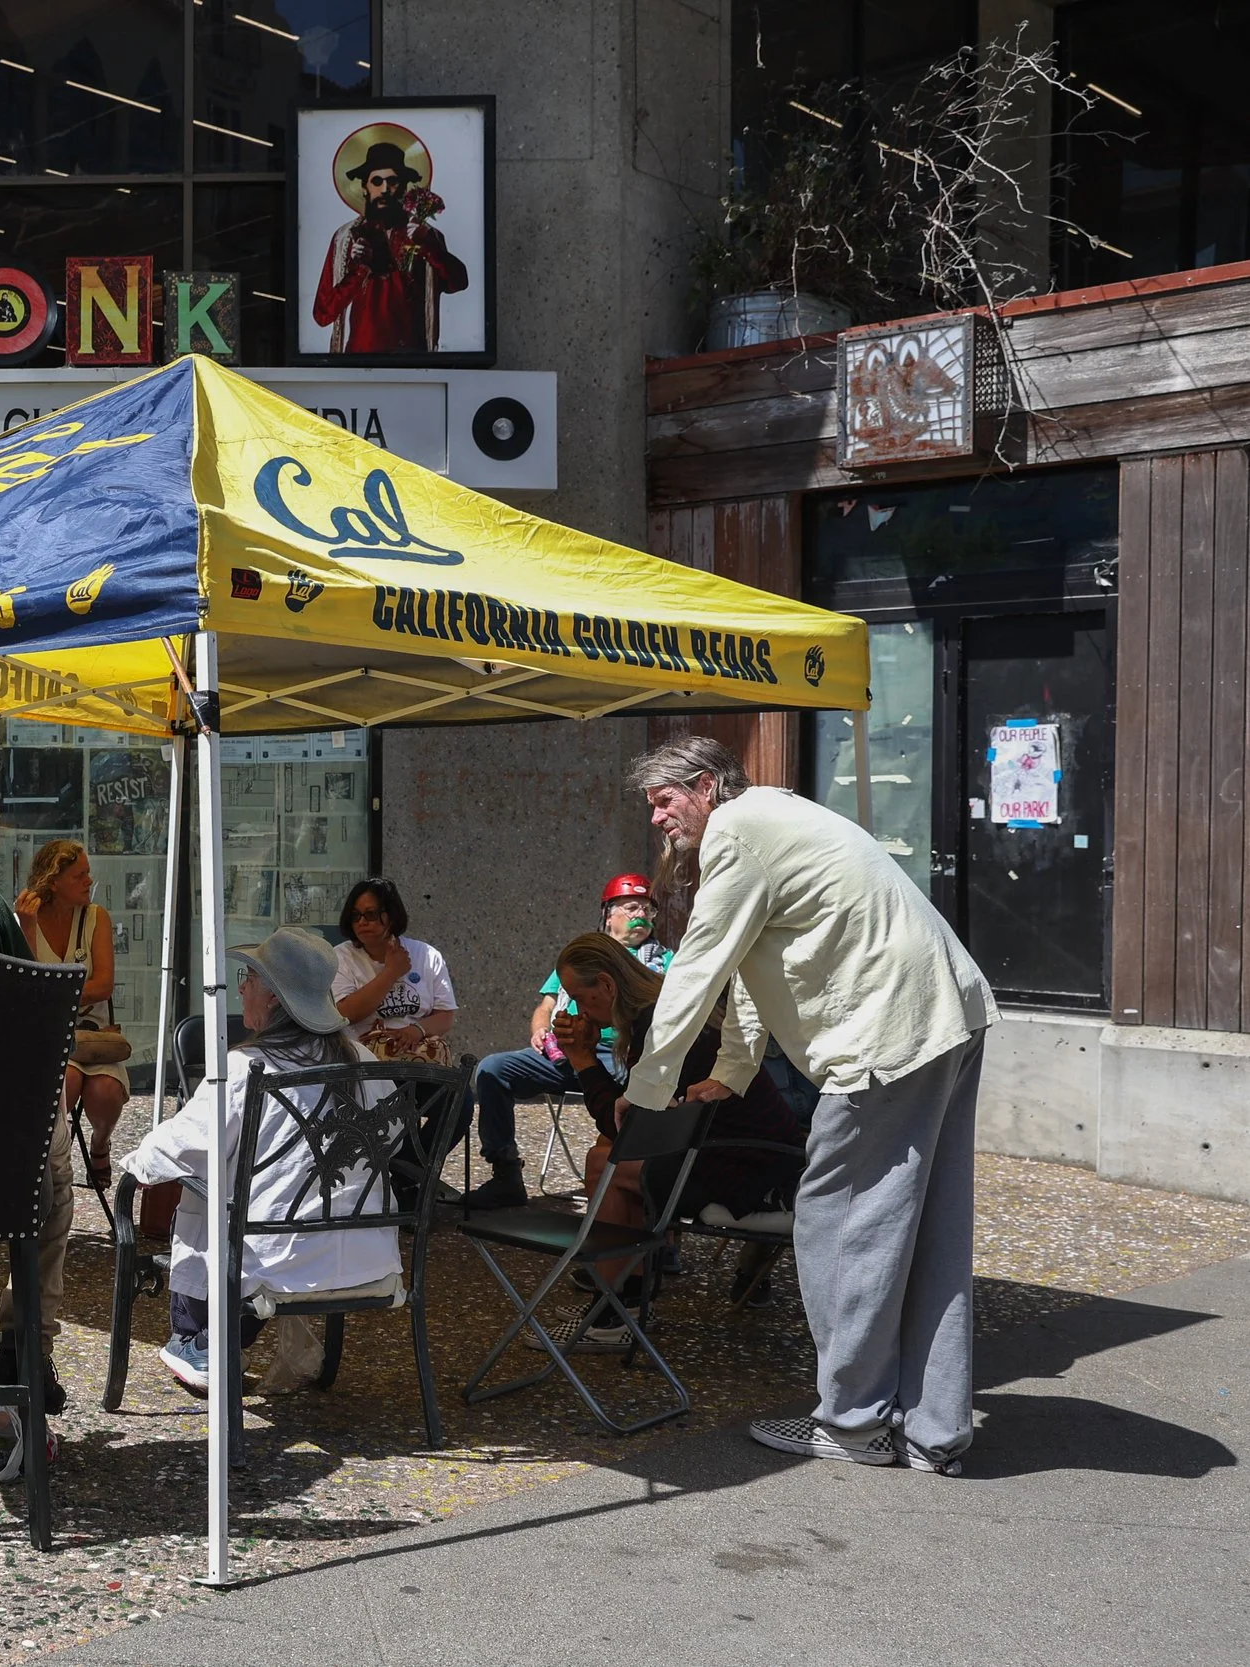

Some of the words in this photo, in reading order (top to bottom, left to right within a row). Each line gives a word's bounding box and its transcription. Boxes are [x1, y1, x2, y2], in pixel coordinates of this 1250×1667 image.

[253, 456, 465, 566] Cal
[372, 585, 573, 658] CALIFORNIA
[572, 613, 692, 673] GOLDEN
[689, 628, 779, 685] BEARS
[998, 728, 1016, 742] OUR
[1018, 727, 1048, 741] PEOPLE
[96, 775, 148, 806] RESIST
[1000, 801, 1021, 818] OUR
[1023, 800, 1050, 818] PARK!
